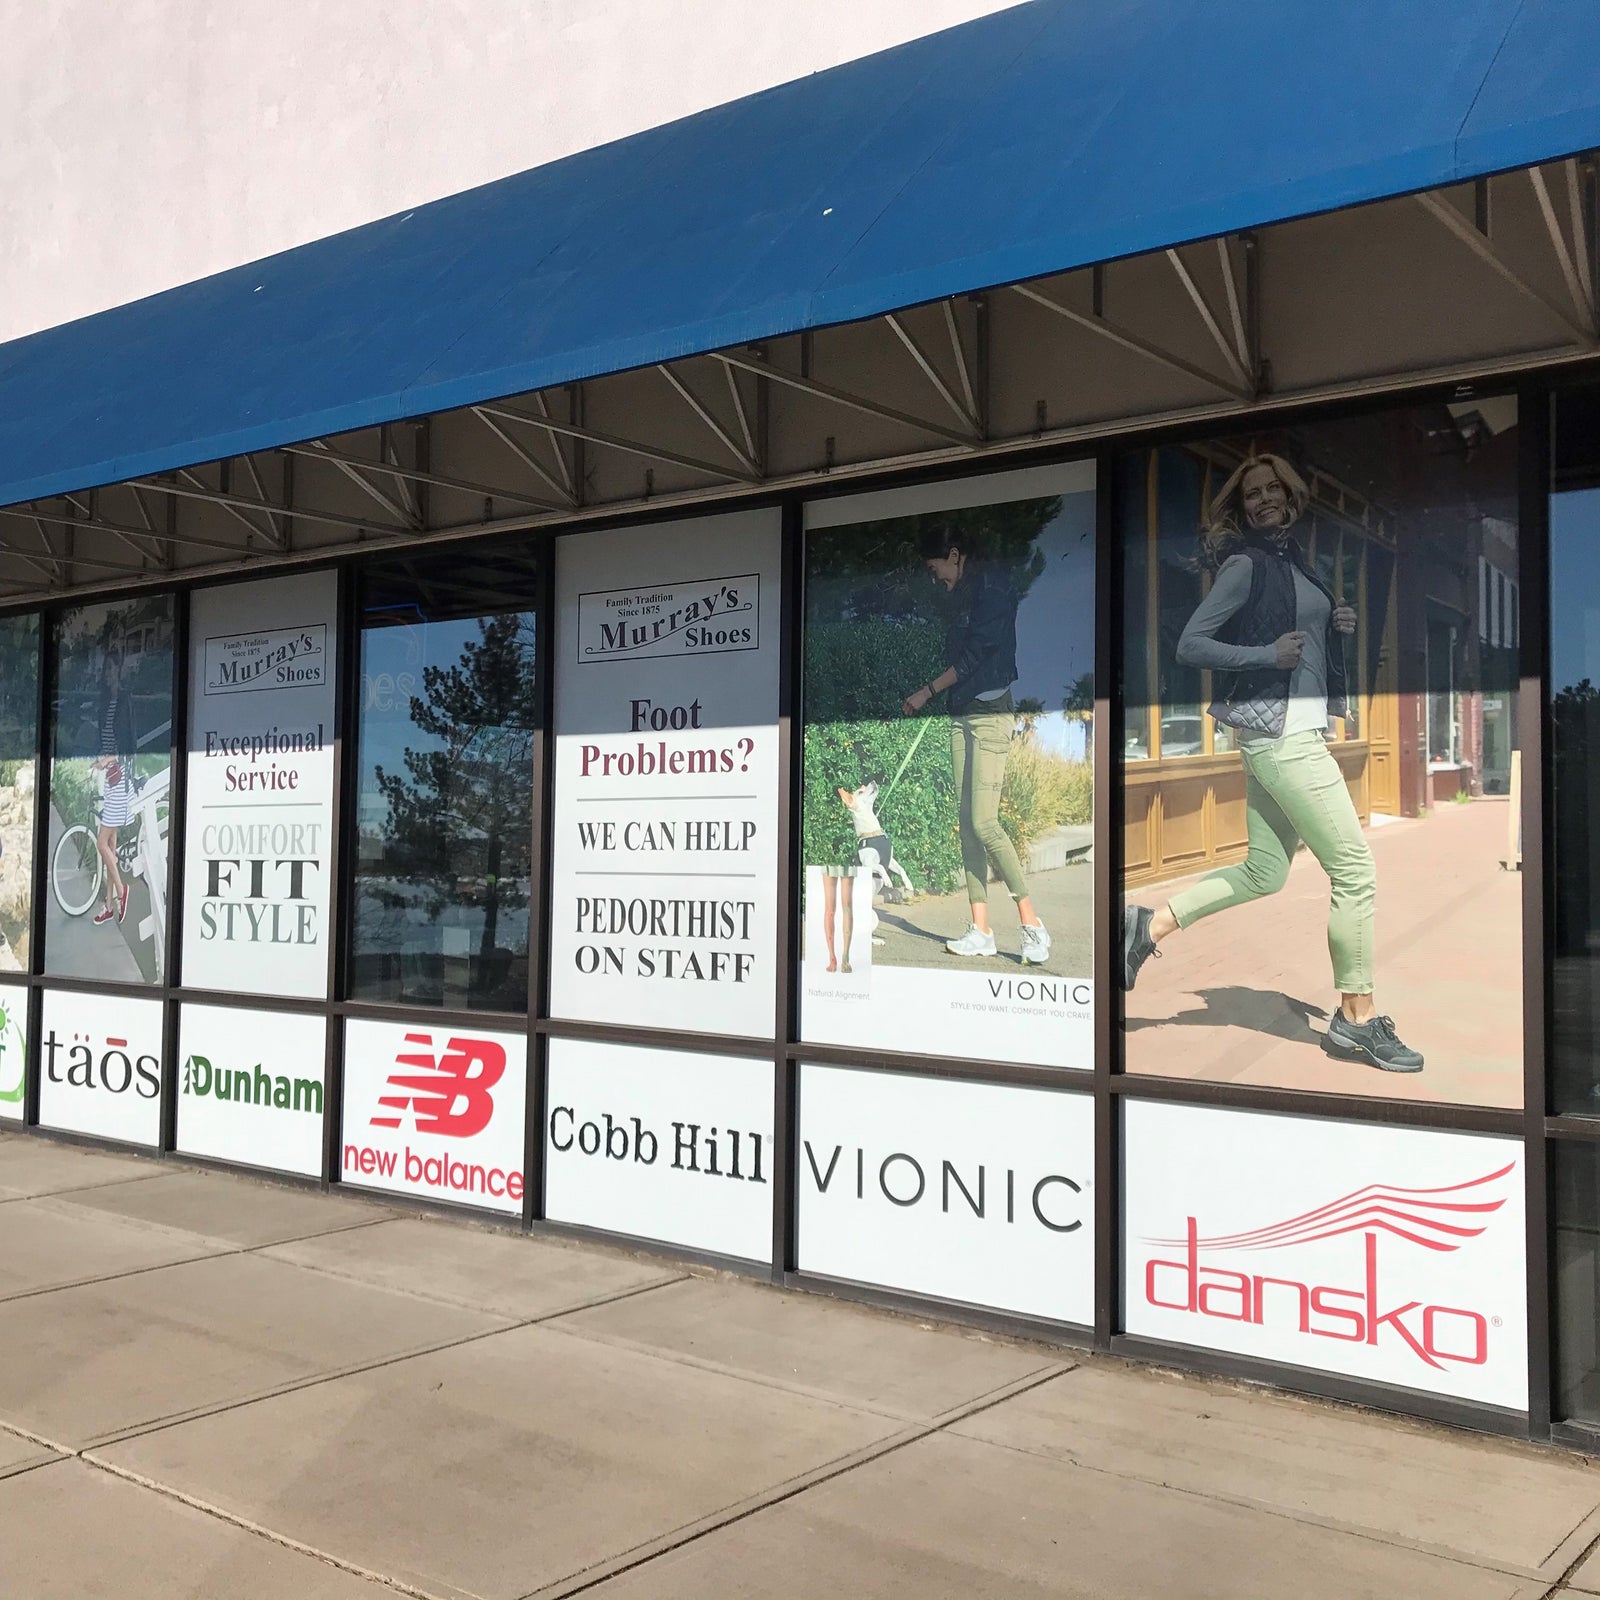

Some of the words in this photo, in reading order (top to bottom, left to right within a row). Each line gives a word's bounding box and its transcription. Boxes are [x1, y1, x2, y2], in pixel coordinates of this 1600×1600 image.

[599, 586, 739, 650] Murray's
[606, 598, 632, 608] Family
[635, 593, 673, 605] Tradition
[618, 609, 639, 617] Since
[641, 605, 660, 615] 1875
[685, 627, 751, 647] Shoes
[219, 634, 312, 684] Murray's
[276, 667, 320, 682] Shoes
[629, 697, 702, 732] Foot
[204, 723, 324, 763] Exceptional
[579, 737, 755, 777] Problems?
[225, 763, 299, 792] Service
[202, 823, 321, 855] COMFORT
[577, 822, 616, 850] WE
[624, 821, 676, 851] CAN
[684, 821, 757, 851] HELP
[201, 859, 319, 900] FIT
[200, 901, 318, 945] STYLE
[575, 897, 755, 940] PEDORTHIST
[575, 945, 626, 975] ON
[637, 948, 755, 983] STAFF
[950, 1001, 971, 1010] STYLE
[972, 1003, 987, 1012] YOU
[1011, 1006, 1048, 1016] COMFORT
[1050, 1009, 1065, 1018] YOU
[988, 978, 1091, 1005] VIONIC
[183, 1054, 324, 1115] Dunham
[550, 1106, 658, 1165] Cobb
[670, 1122, 767, 1184] Hill
[344, 1144, 398, 1178] new
[404, 1146, 524, 1201] balance
[803, 1140, 1084, 1234] VIONIC
